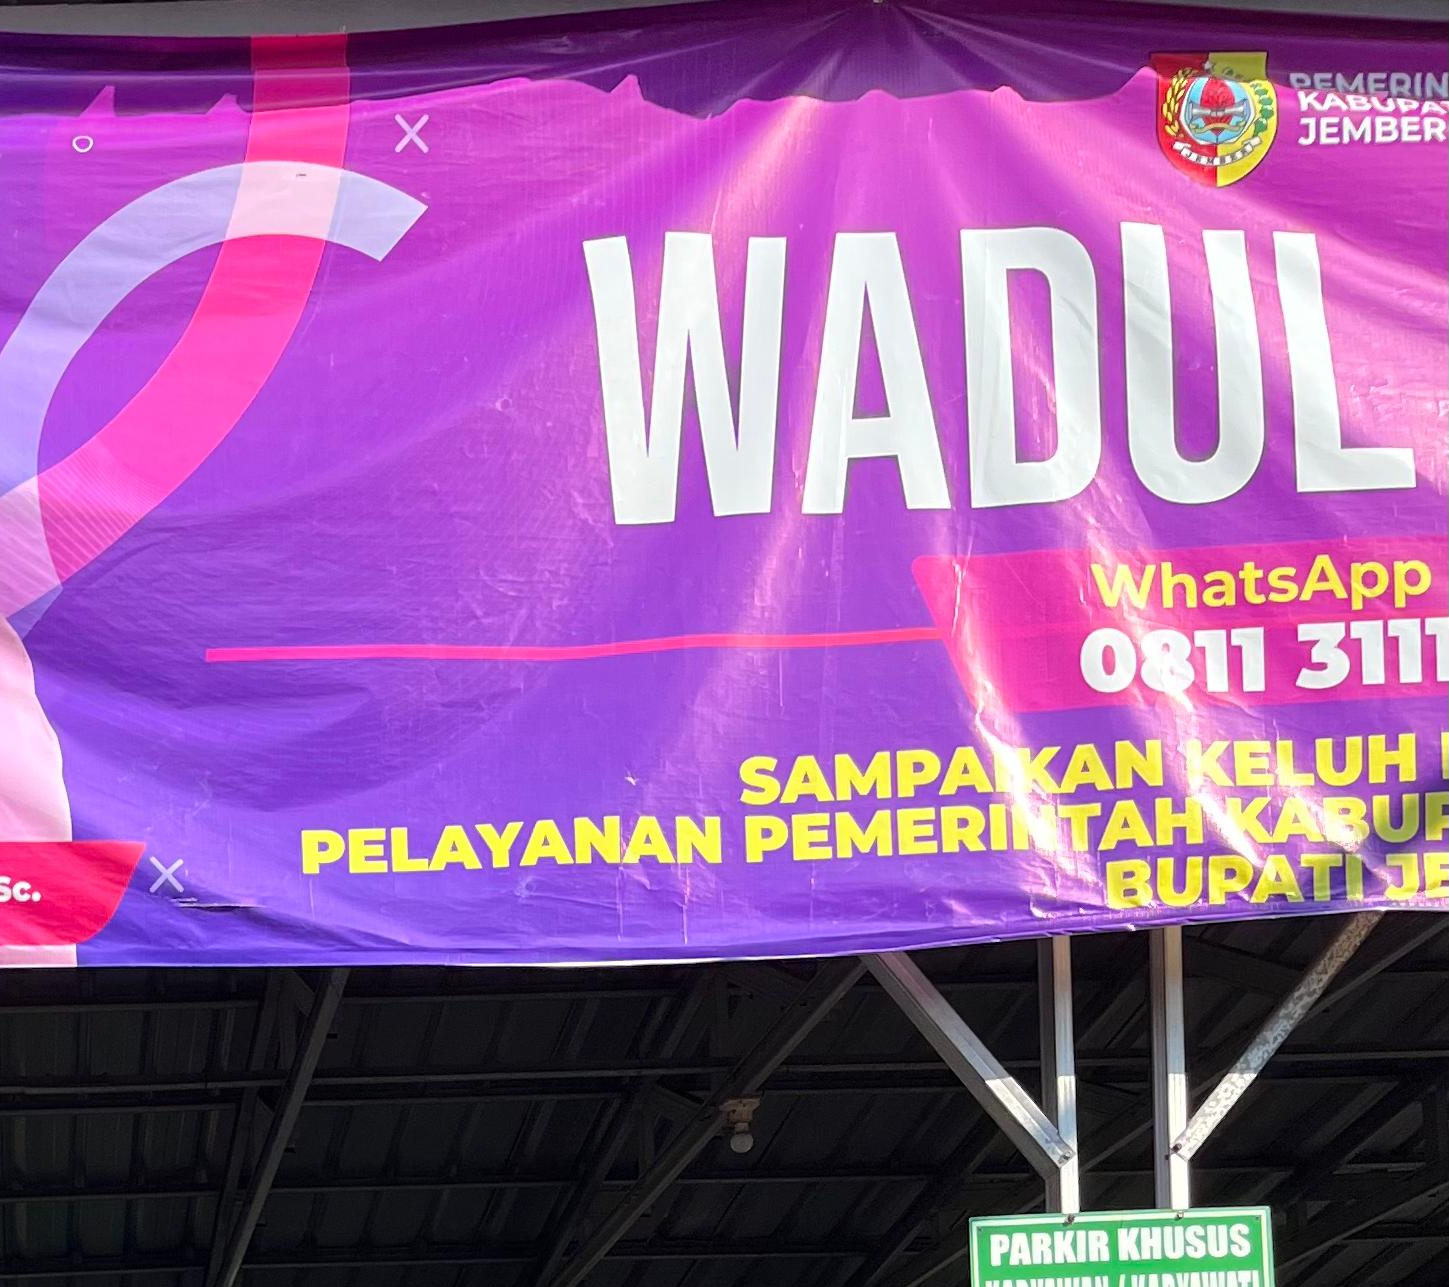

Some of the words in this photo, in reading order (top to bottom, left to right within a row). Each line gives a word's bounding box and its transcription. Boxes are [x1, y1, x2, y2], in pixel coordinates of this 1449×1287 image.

[1297, 116, 1447, 145] JEMBER
[581, 221, 1417, 525] WADUL
[1090, 554, 1432, 611] WhatsApp
[1080, 627, 1266, 693] 0811
[739, 739, 1164, 806] SAMPAIKAN
[1185, 733, 1417, 788] KELUH
[300, 815, 722, 875] PELAYANAN
[744, 796, 1204, 864] PEMERINTAH
[1105, 853, 1364, 910] BUPATI
[989, 1229, 1110, 1267] PARKIR
[1117, 1223, 1252, 1262] KHUSUS
